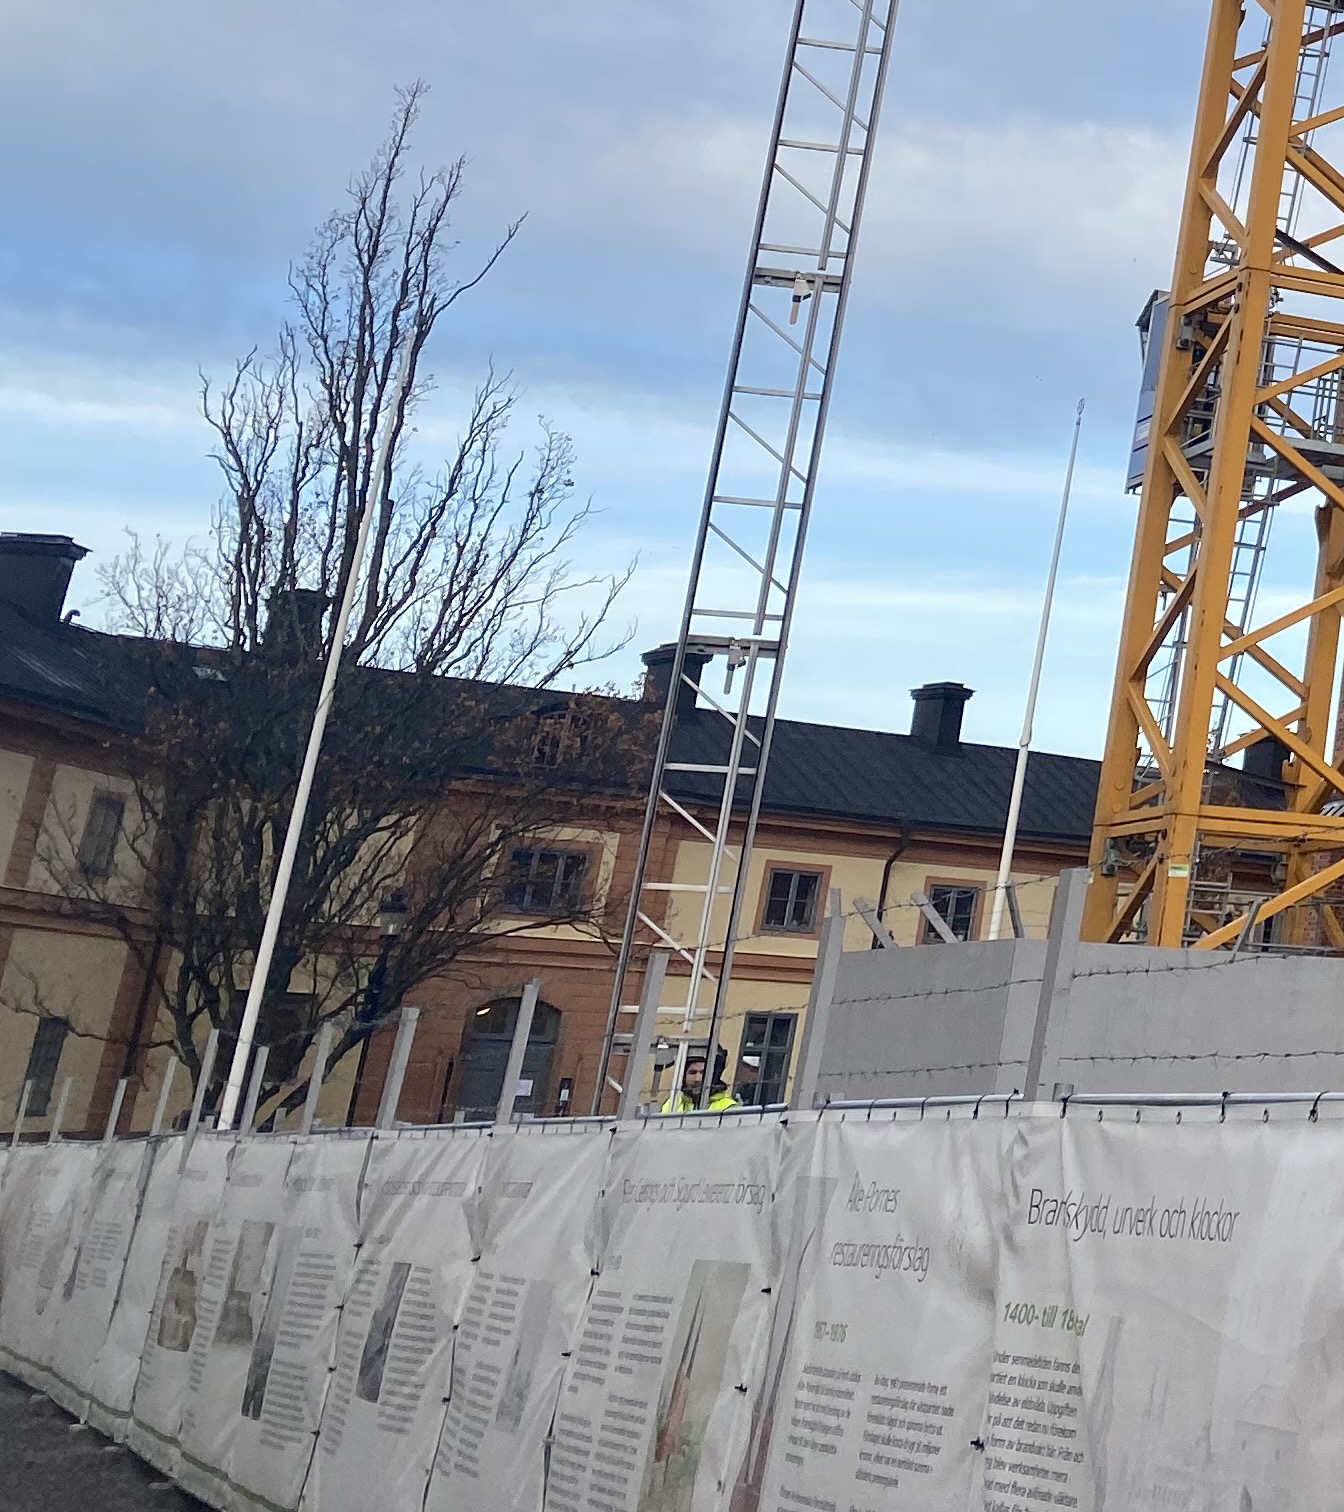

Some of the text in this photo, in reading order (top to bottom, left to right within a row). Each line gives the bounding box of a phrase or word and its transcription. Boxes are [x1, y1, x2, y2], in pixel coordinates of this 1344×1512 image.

[1112, 1195, 1157, 1237] urverk
[1159, 1196, 1186, 1238] och
[1189, 1196, 1240, 1242] klockor
[1004, 1302, 1039, 1325] 1400-
[1041, 1305, 1058, 1328] till
